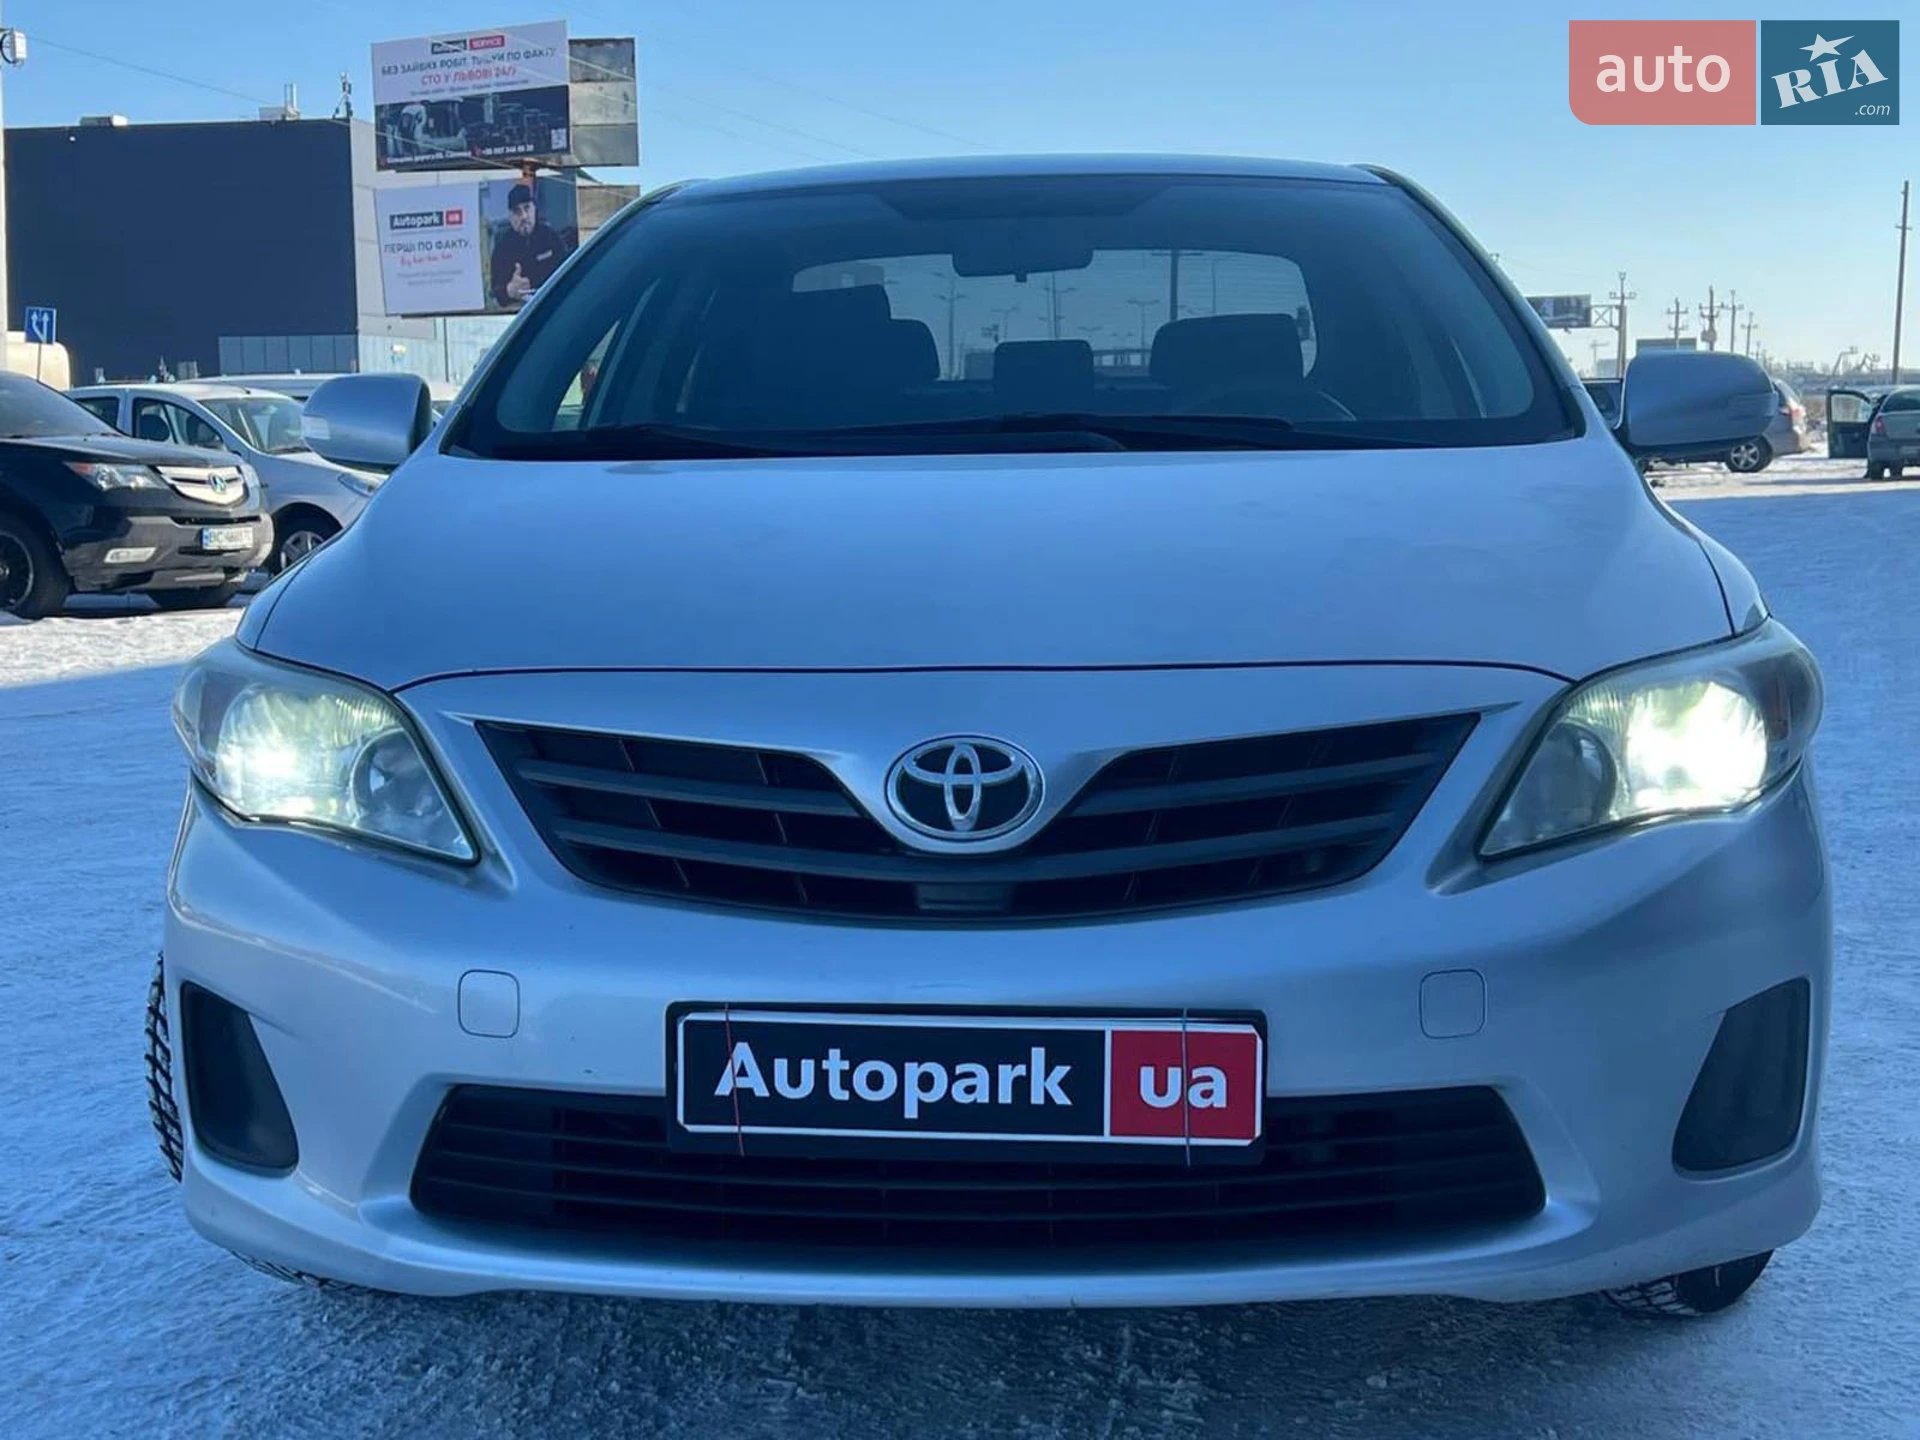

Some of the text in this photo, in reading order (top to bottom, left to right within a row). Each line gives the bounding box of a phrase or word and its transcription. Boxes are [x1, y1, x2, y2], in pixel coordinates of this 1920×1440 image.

[507, 51, 521, 61] ПО
[421, 73, 441, 85] СТО
[393, 212, 440, 227] Autopark
[417, 240, 433, 251] ПО
[713, 1040, 1229, 1119] Autopark ua
